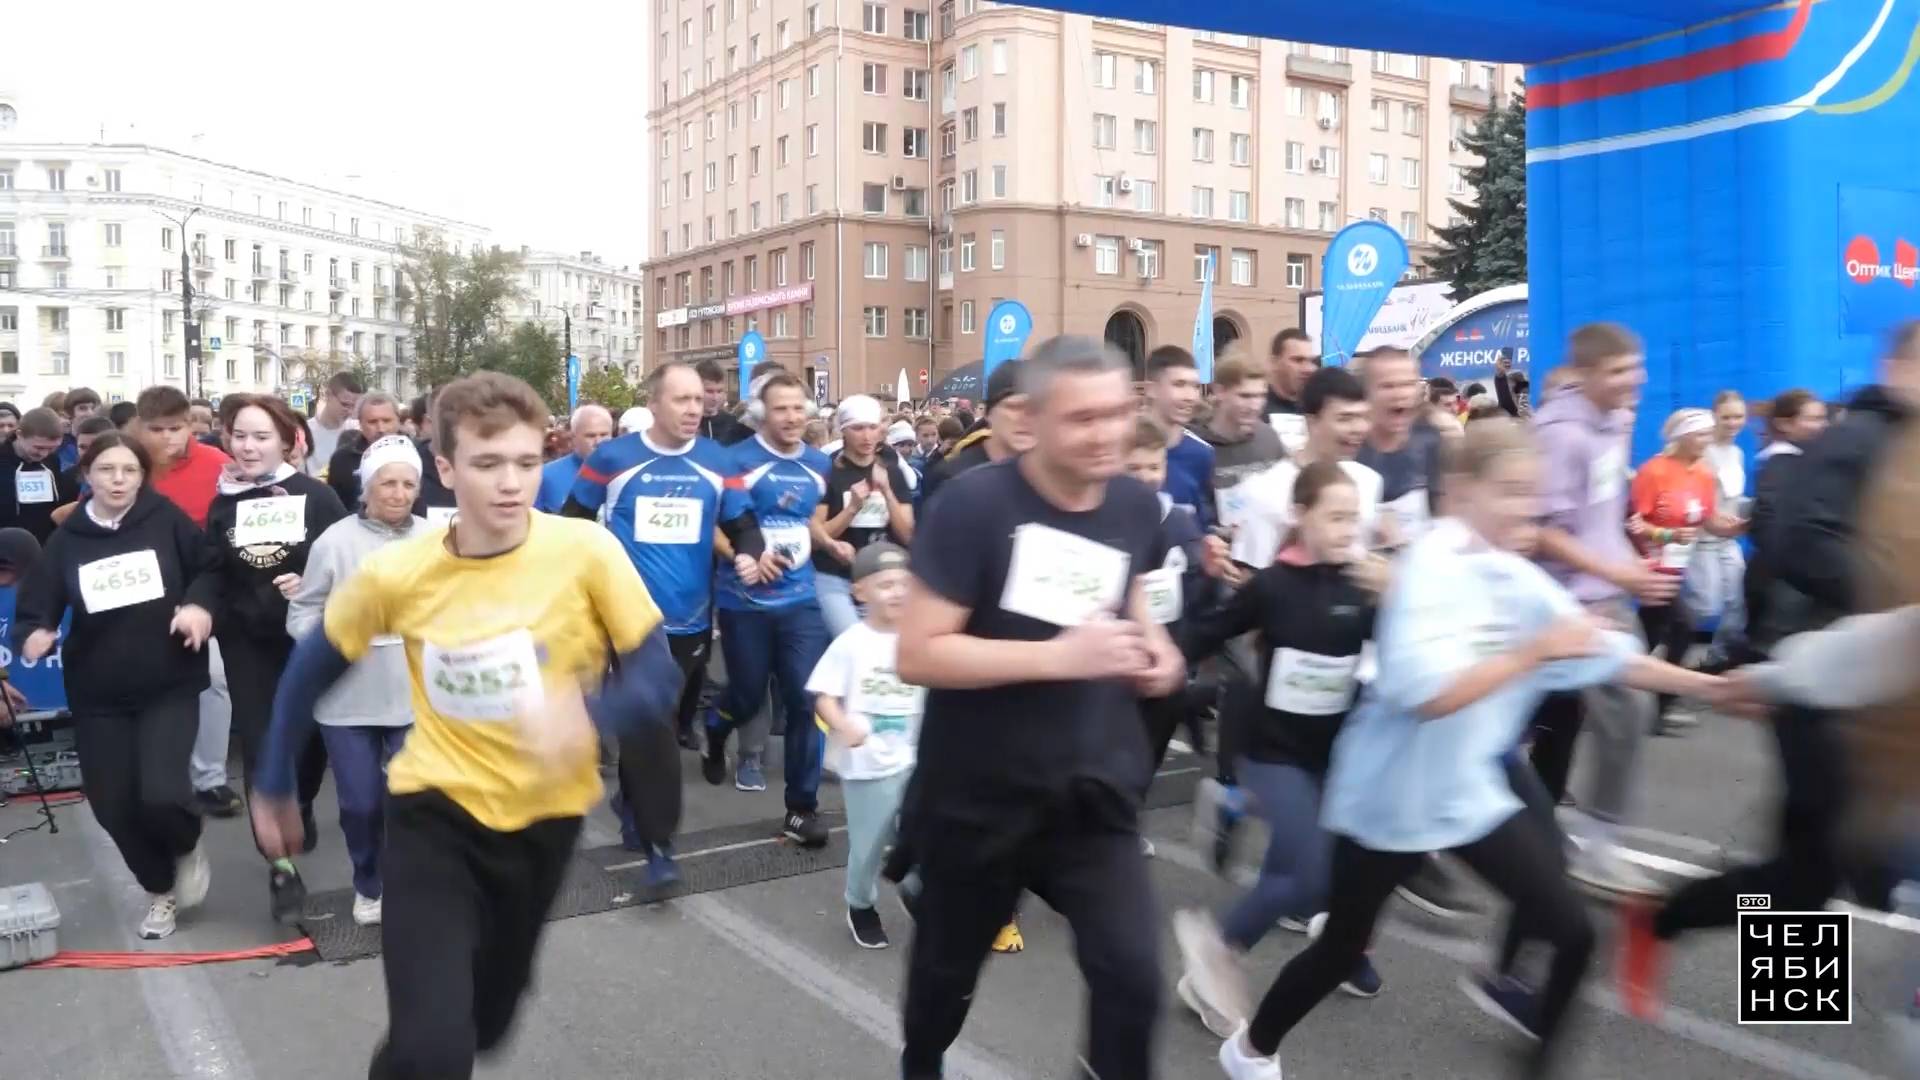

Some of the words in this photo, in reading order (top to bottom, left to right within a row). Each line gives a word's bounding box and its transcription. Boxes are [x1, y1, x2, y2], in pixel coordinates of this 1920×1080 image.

[1846, 259, 1891, 277] Оптик
[1440, 347, 1503, 367] ЖЕНСКА
[242, 510, 298, 529] 4649
[648, 512, 689, 529] 4211
[91, 567, 151, 593] 4655
